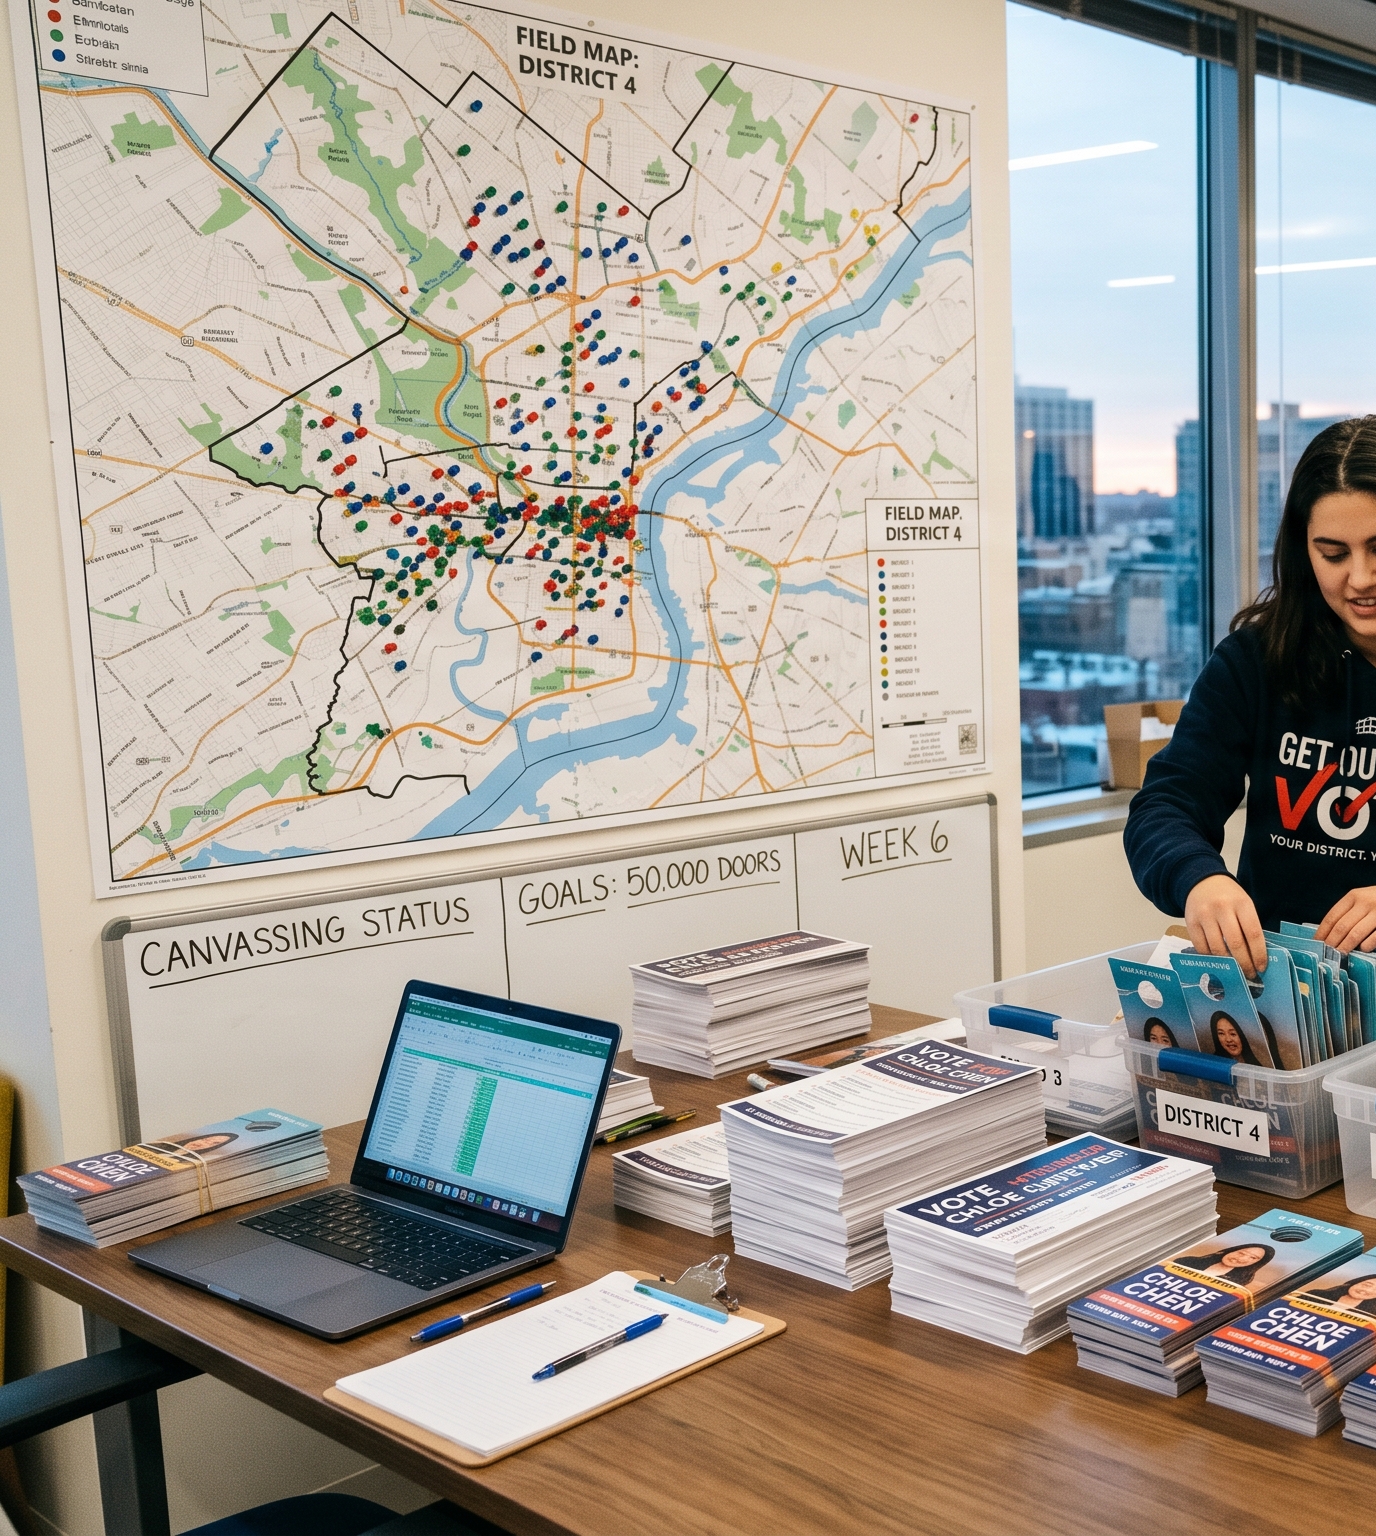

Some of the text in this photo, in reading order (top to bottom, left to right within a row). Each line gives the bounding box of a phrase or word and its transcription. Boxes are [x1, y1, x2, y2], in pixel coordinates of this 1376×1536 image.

[517, 25, 639, 69] FIELD MAP:
[519, 54, 637, 94] DISTRICT 4
[885, 506, 925, 520] FIELD
[886, 526, 962, 541] DISTRICT 4
[1279, 732, 1334, 771] GET
[840, 820, 949, 869] WEEK 6
[1270, 834, 1303, 850] YOUR
[1307, 842, 1366, 861] DISTRICT.
[518, 873, 617, 915] GOALS:
[718, 850, 781, 880] DOORS
[140, 897, 470, 976] CANVASSING STATUS
[919, 1045, 974, 1067] VOTE
[1053, 1070, 1062, 1086] 3
[1165, 1104, 1243, 1138] DISTRICT
[1249, 1124, 1260, 1142] 4
[918, 1183, 1001, 1217] VOTE
[945, 1191, 1025, 1225] CHLOE
[1123, 1282, 1203, 1315] CHEN
[1143, 1271, 1222, 1304] CHLOE
[1249, 1316, 1338, 1352] CHEN
[1267, 1307, 1357, 1339] CHLOE
